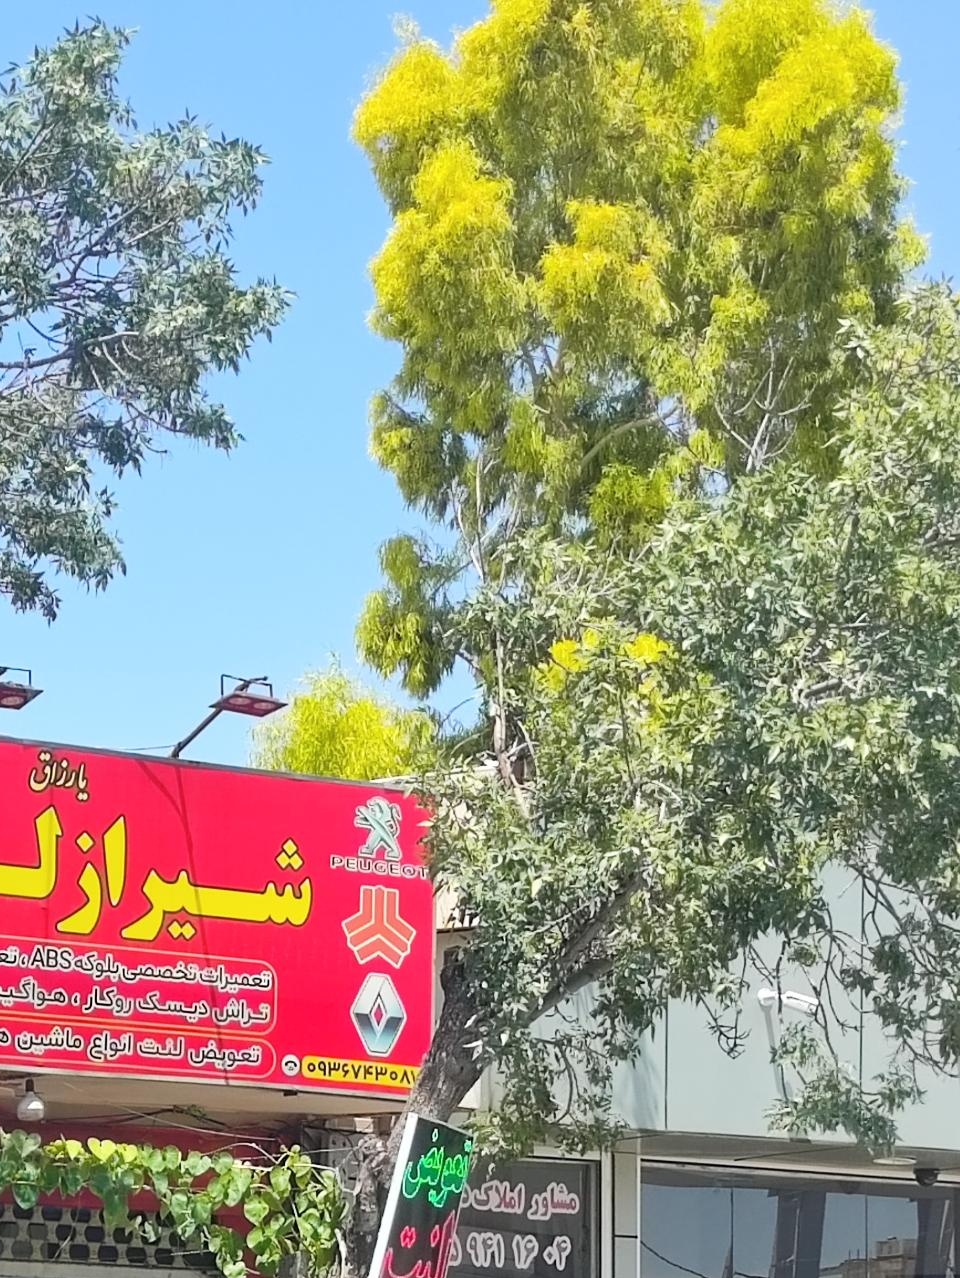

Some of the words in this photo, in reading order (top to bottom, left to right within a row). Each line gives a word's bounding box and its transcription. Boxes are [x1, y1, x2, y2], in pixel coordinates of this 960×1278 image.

[56, 814, 313, 941] شیراز
[330, 855, 430, 880] PEUGEOT
[30, 947, 73, 970] ABS
[123, 960, 198, 982] تخصصی
[199, 966, 272, 992] تعمیرات
[83, 986, 132, 1014] روکار
[137, 993, 209, 1020] دیسک
[213, 1000, 269, 1025] تراش
[17, 1028, 83, 1051] ماشین
[89, 1033, 133, 1059] انواع
[137, 1037, 183, 1058] لنت
[190, 1045, 261, 1068] تعویض
[471, 1180, 526, 1215] املاک
[527, 1182, 580, 1221] مشاور
